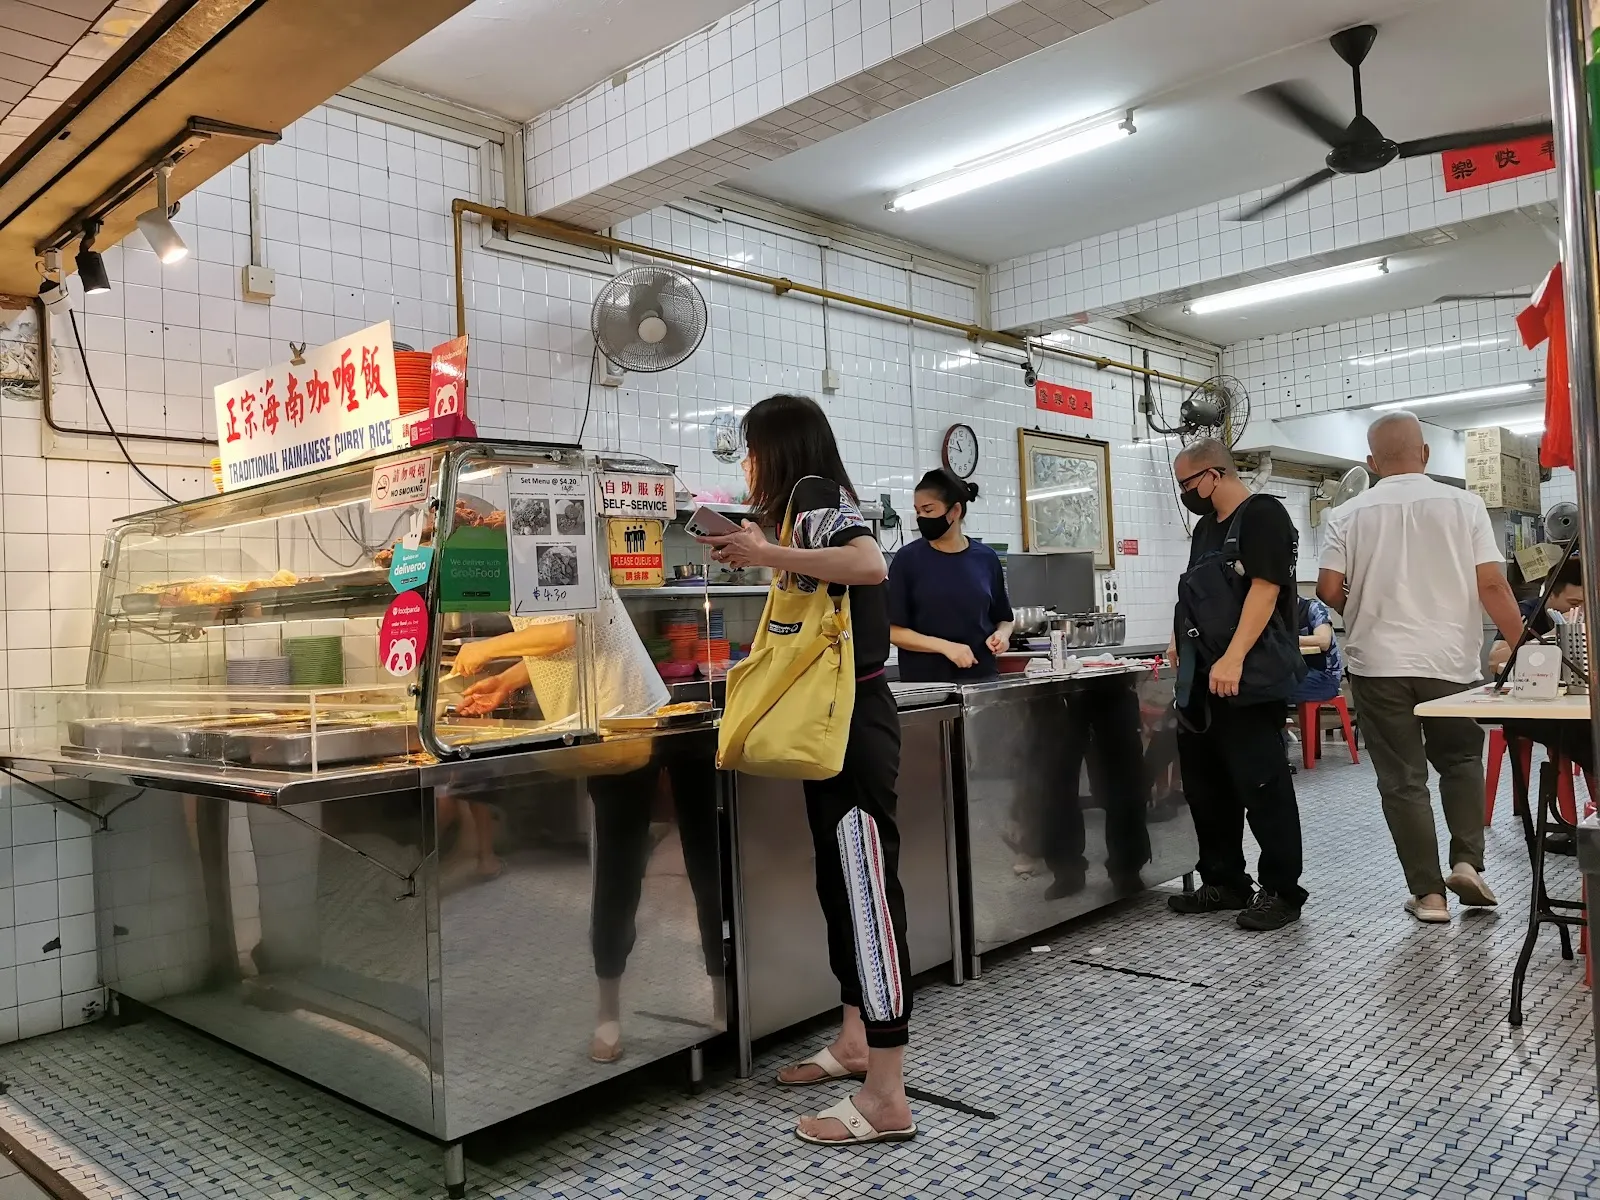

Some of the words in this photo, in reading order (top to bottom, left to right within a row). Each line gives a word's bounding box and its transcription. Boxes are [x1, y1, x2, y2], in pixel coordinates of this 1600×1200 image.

[228, 451, 280, 484] TRADITIONAL
[281, 436, 332, 471] HAINANESE
[368, 419, 392, 448] RICE
[532, 477, 551, 485] Menu
[551, 477, 558, 486] @
[559, 477, 577, 486] $4.20
[391, 489, 399, 497] NO
[399, 484, 423, 497] SMOKING
[605, 480, 665, 497] 自助服務
[603, 498, 668, 511] SELF-SERVICE
[450, 558, 461, 566] We
[462, 558, 485, 566] deliver
[613, 556, 635, 566] PLEASE
[635, 556, 652, 566] QUEUE
[652, 556, 660, 566] UP
[393, 561, 427, 576] deliveroo
[450, 567, 501, 578] GrabFood
[398, 605, 421, 615] foodpanda
